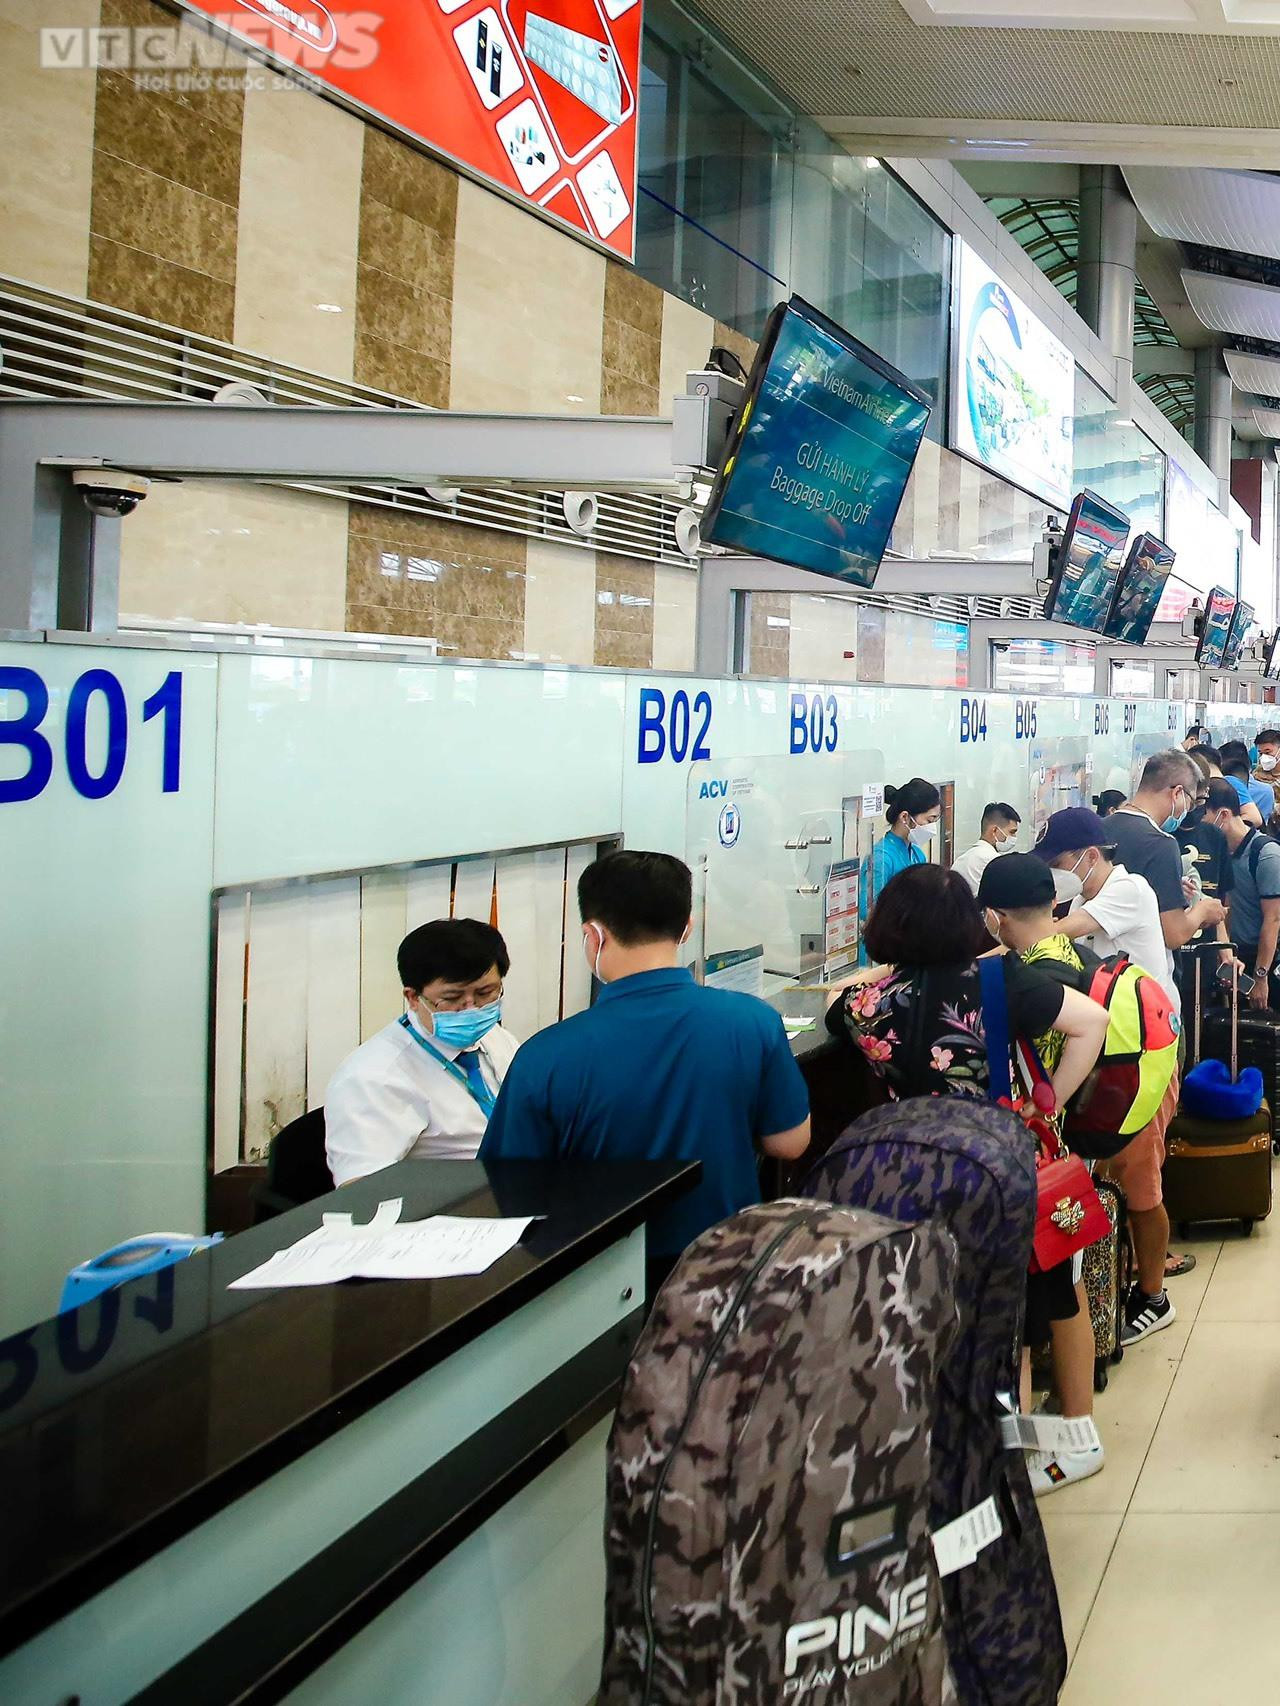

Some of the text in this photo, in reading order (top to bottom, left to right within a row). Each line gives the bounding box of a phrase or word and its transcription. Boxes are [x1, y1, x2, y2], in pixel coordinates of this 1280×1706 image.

[796, 441, 822, 471] GỬI
[820, 453, 856, 487] HÀNH
[770, 466, 872, 525] Baggage Drop Off
[0, 666, 183, 803] B01
[637, 687, 712, 764] B02
[789, 693, 839, 755] B03
[960, 698, 987, 743] B04
[1015, 700, 1037, 739] B05
[1094, 703, 1109, 735] B06
[1123, 704, 1137, 733] B07
[699, 779, 729, 799] ACV
[784, 1573, 928, 1677] PING
[783, 1666, 837, 1698] PLAY
[842, 1646, 892, 1680] YOUR
